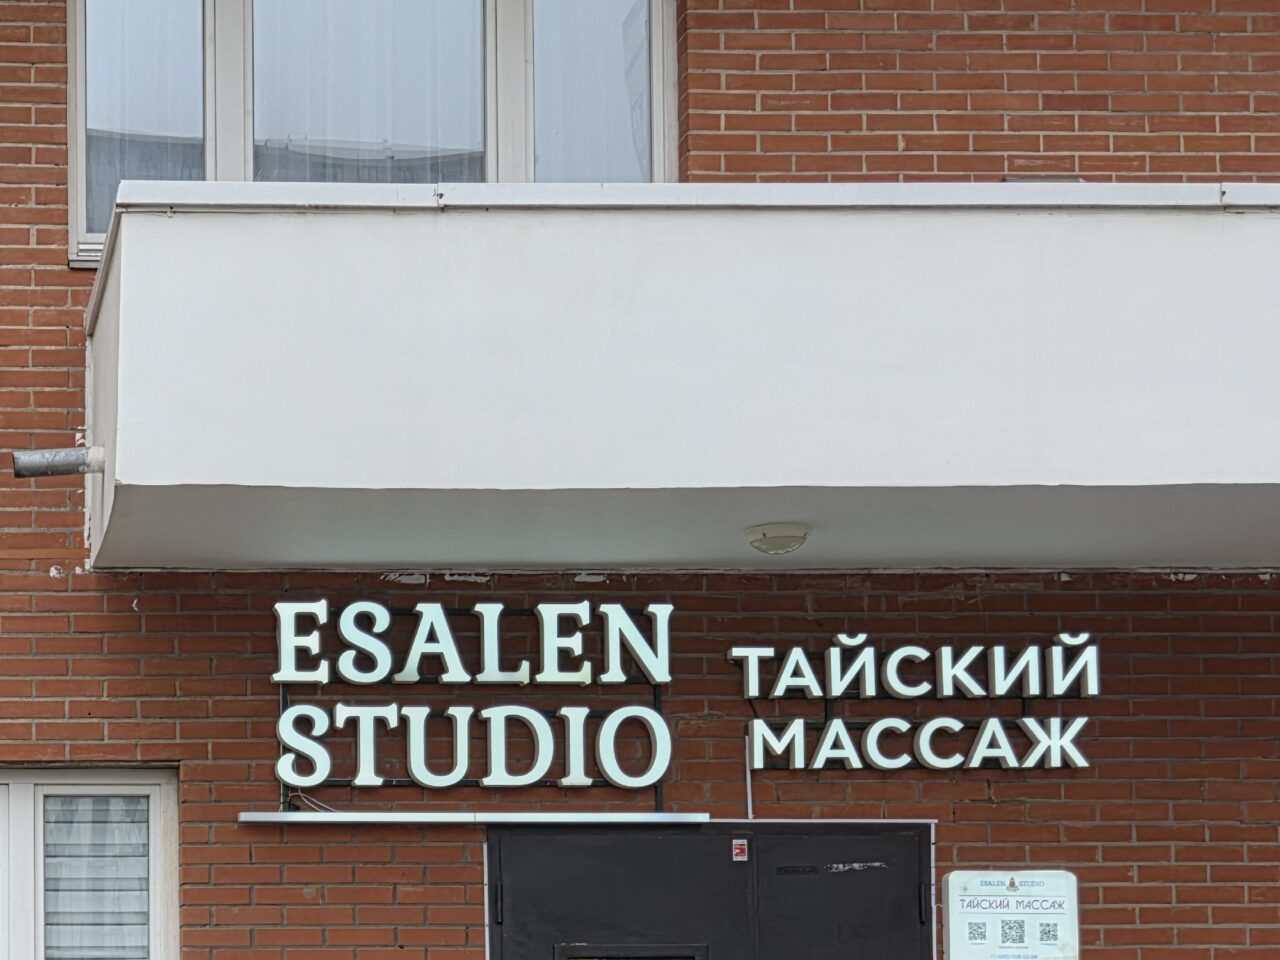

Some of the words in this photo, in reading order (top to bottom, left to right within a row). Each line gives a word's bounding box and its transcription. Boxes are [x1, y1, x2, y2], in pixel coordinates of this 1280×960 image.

[271, 598, 674, 686] ESALEN
[728, 633, 1099, 699] ТАЙСКИЙ
[275, 702, 672, 789] STUDIO
[748, 716, 1090, 771] МАССАЖ
[959, 897, 1010, 910] ТАЙСКИЙ
[1016, 899, 1065, 910] МАССАЖ
